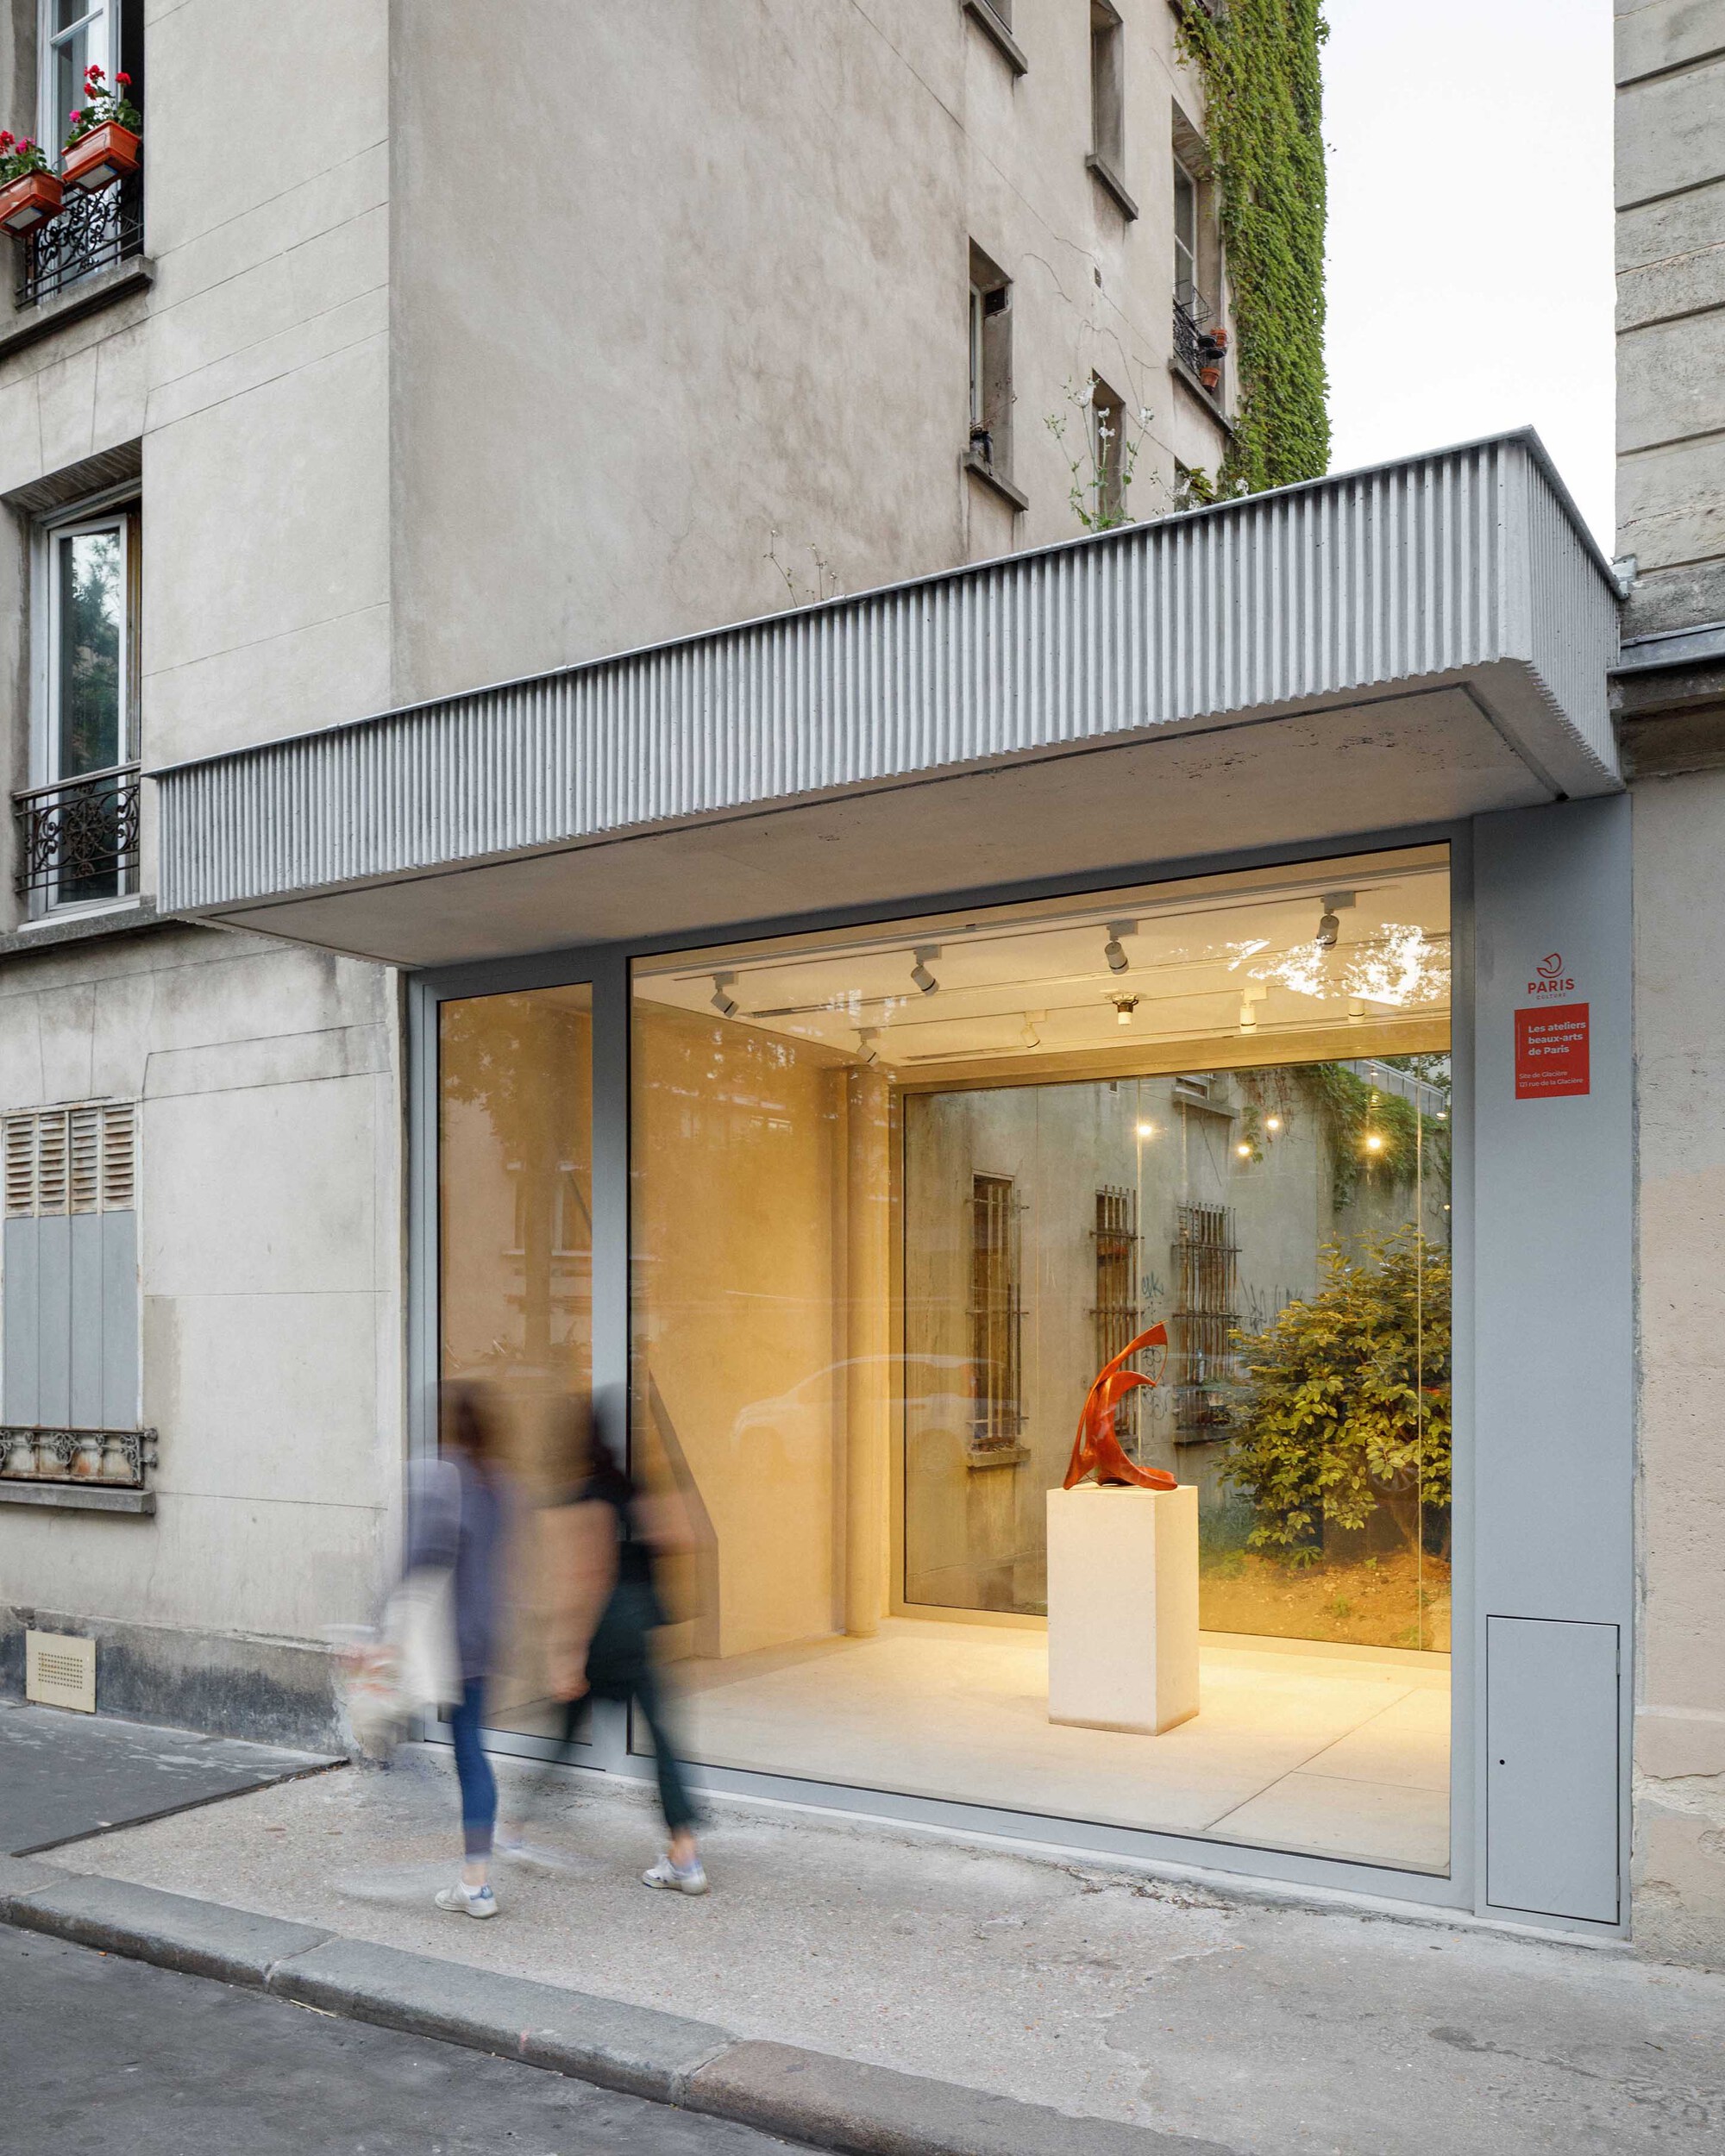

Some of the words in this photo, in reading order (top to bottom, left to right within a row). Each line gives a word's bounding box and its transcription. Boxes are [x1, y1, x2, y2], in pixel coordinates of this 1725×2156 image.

[1527, 978, 1575, 994] PARIS
[1547, 1021, 1586, 1031] ateliers
[1528, 1033, 1584, 1044] beaux-arts
[1528, 1047, 1541, 1056] de
[1544, 1045, 1570, 1054] Paris
